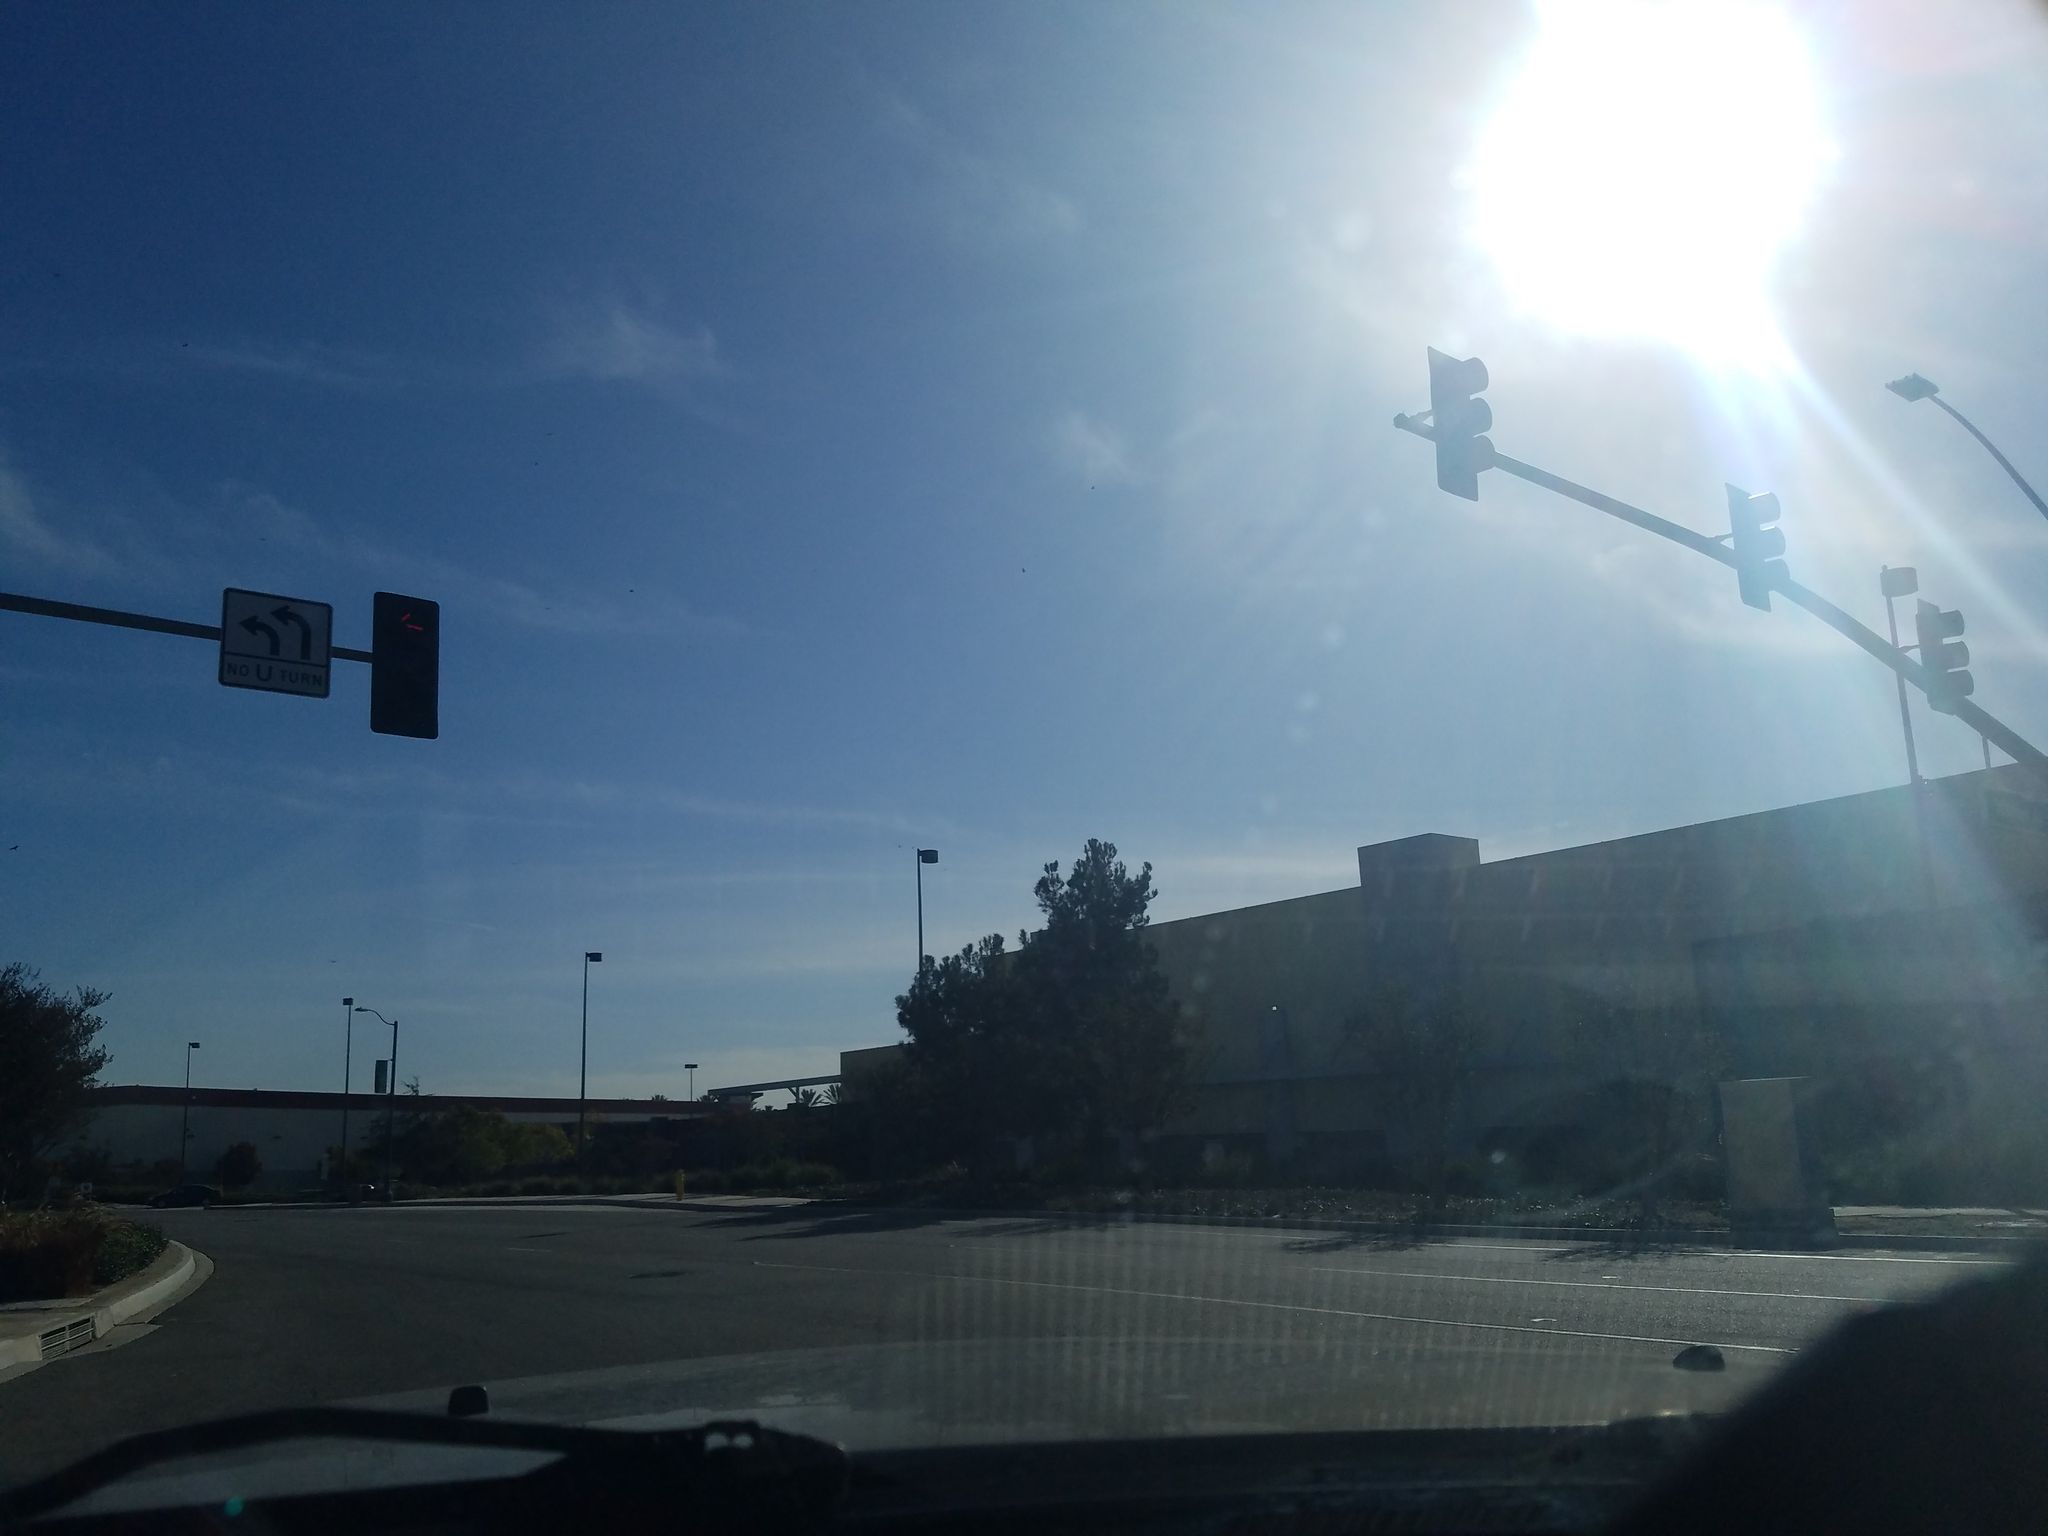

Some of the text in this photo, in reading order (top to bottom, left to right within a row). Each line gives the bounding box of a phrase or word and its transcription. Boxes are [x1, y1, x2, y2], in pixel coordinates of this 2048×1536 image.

[227, 663, 322, 686] NO U TURN
